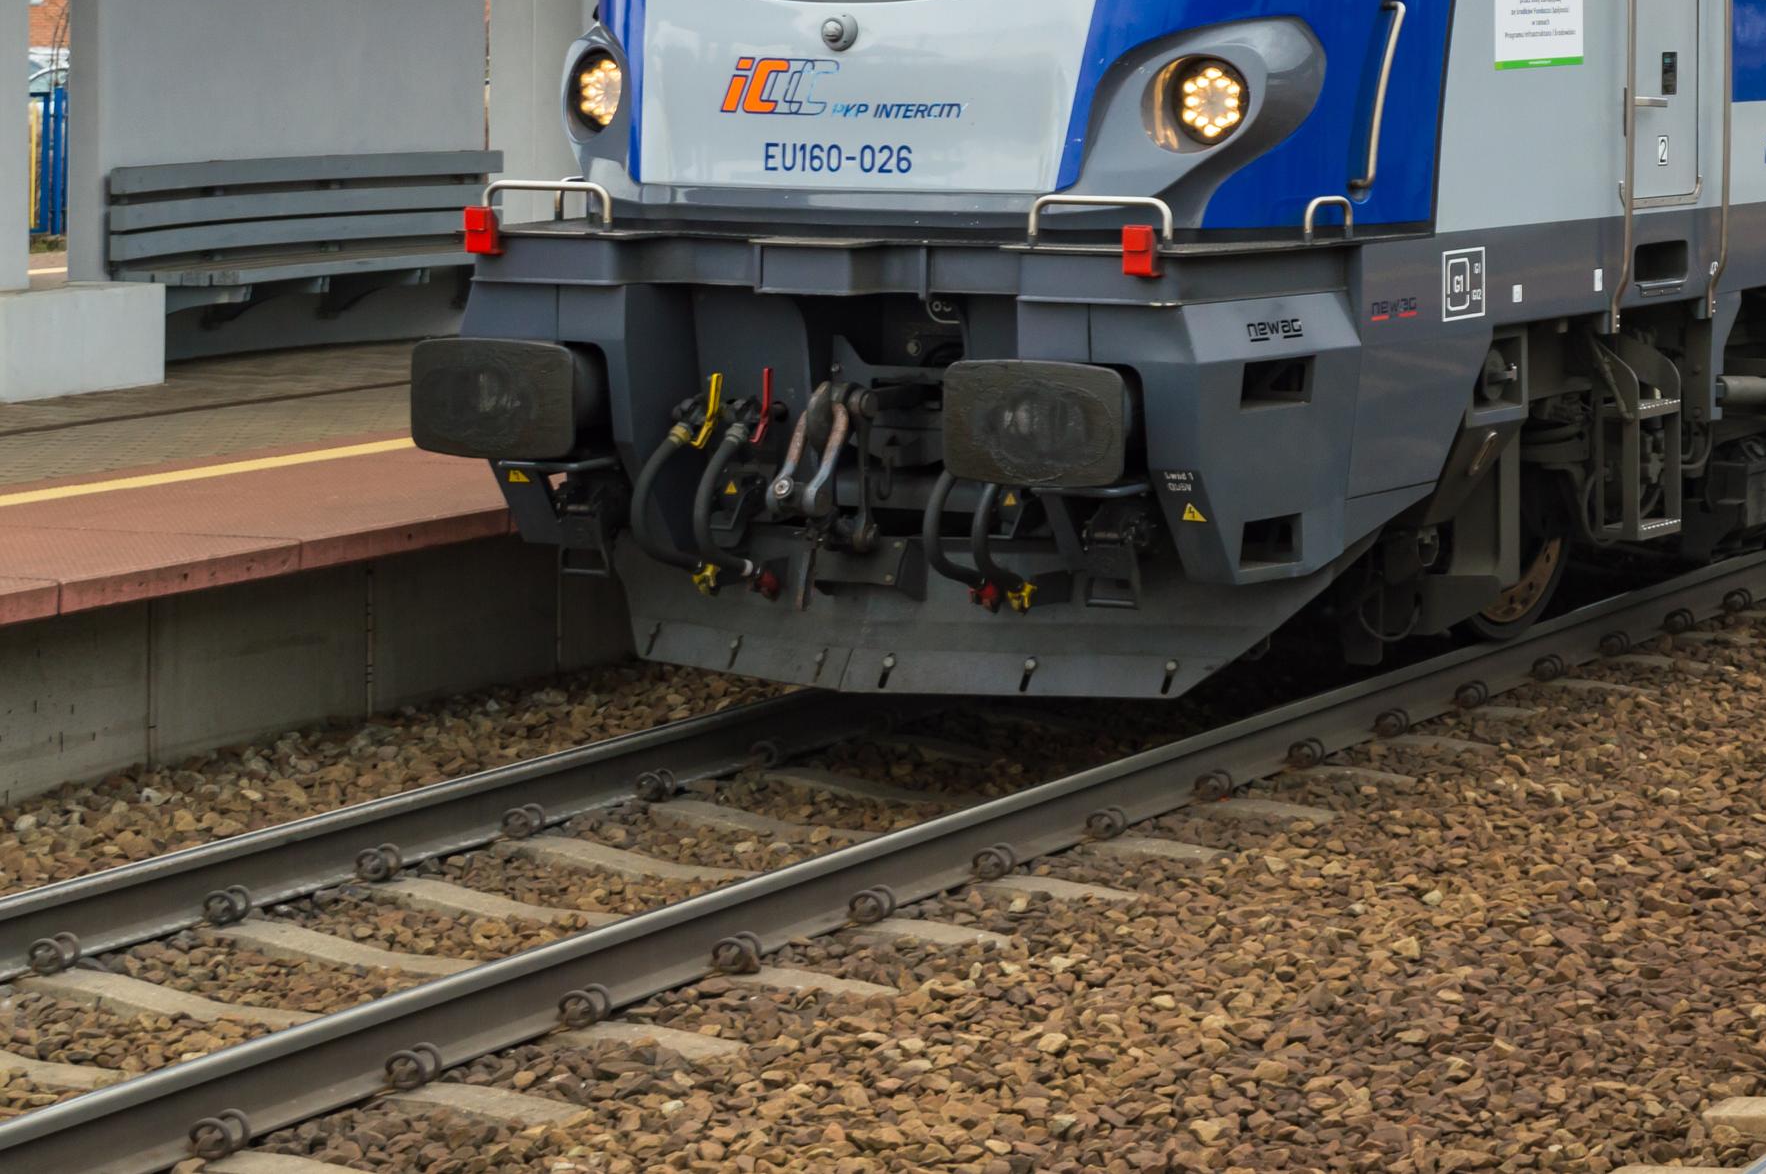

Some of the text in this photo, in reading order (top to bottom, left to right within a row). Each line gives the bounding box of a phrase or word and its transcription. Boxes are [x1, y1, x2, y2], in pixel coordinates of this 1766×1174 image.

[831, 102, 968, 119] PKP INTERCITY
[764, 142, 913, 173] EU160-026
[1659, 137, 1668, 164] 2
[1246, 318, 1303, 338] newag
